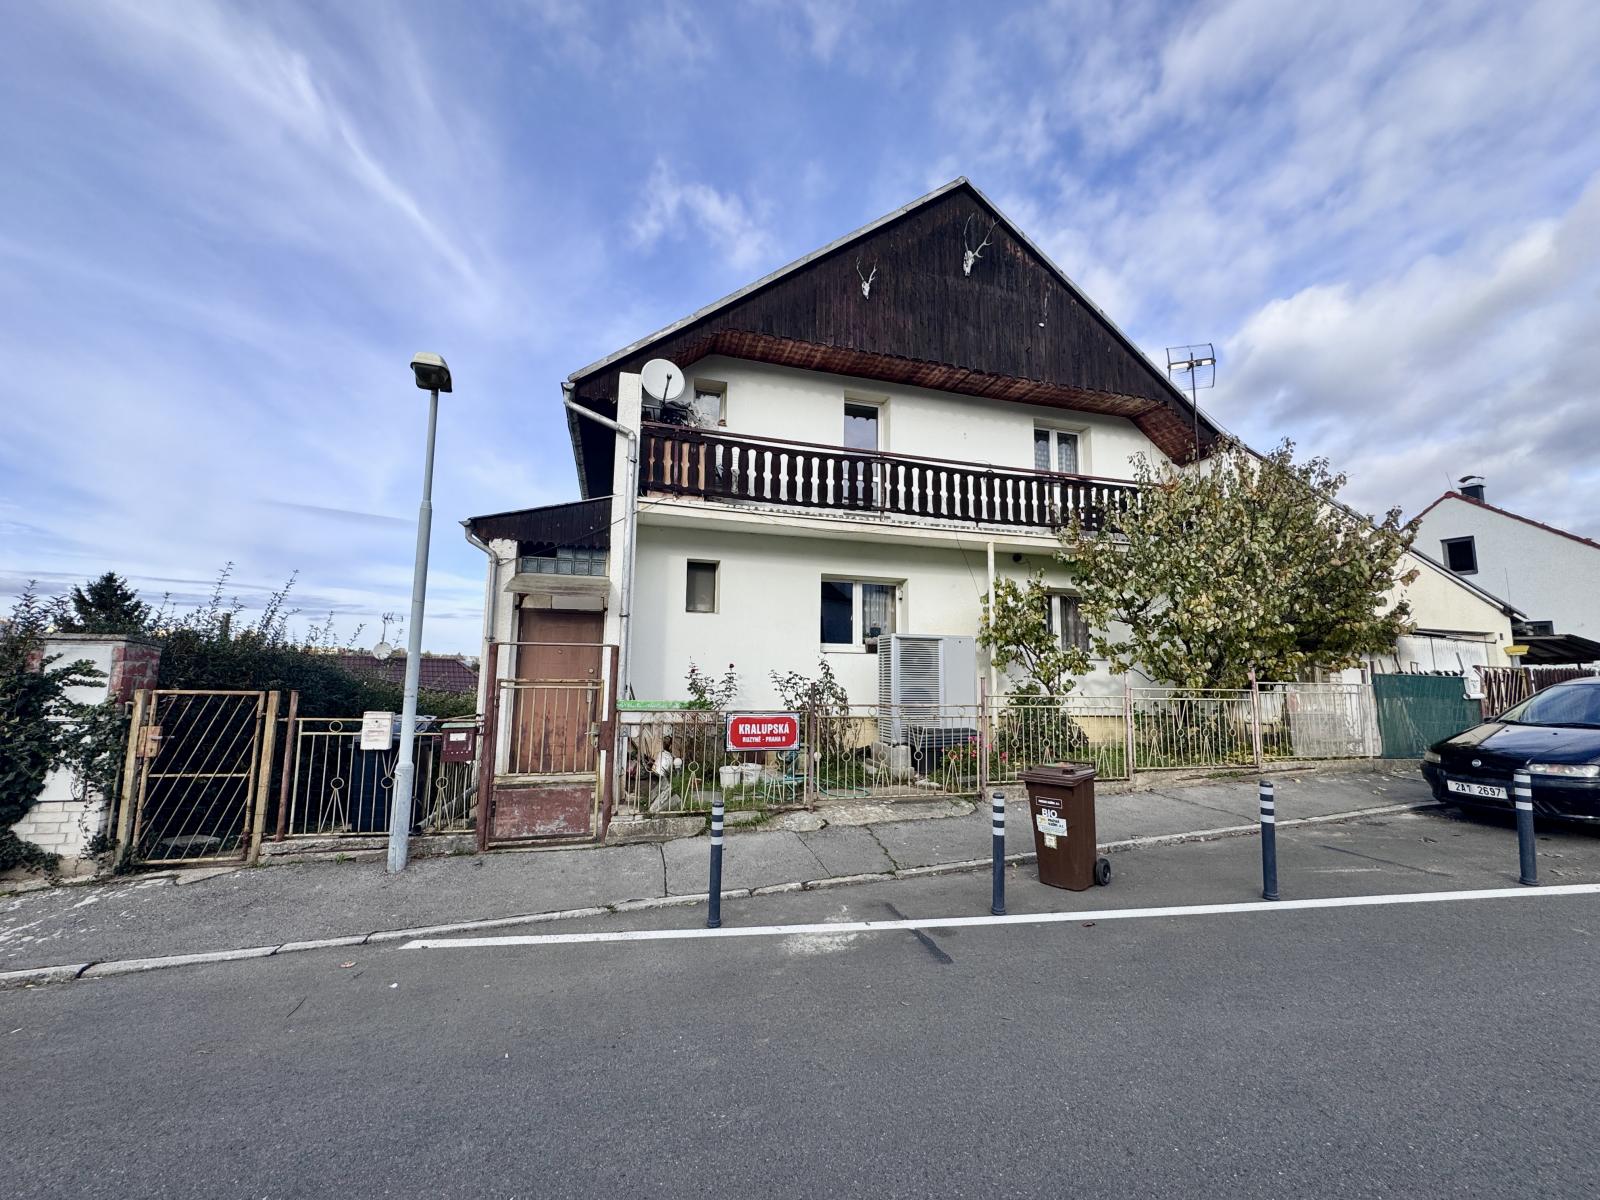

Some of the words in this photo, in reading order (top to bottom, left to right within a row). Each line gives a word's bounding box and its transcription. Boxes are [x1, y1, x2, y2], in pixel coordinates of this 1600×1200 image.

[739, 722, 790, 734] KRALUPSKÁ
[1455, 783, 1471, 792] 2A1
[1477, 786, 1501, 797] 2697
[1042, 808, 1058, 818] BIO
